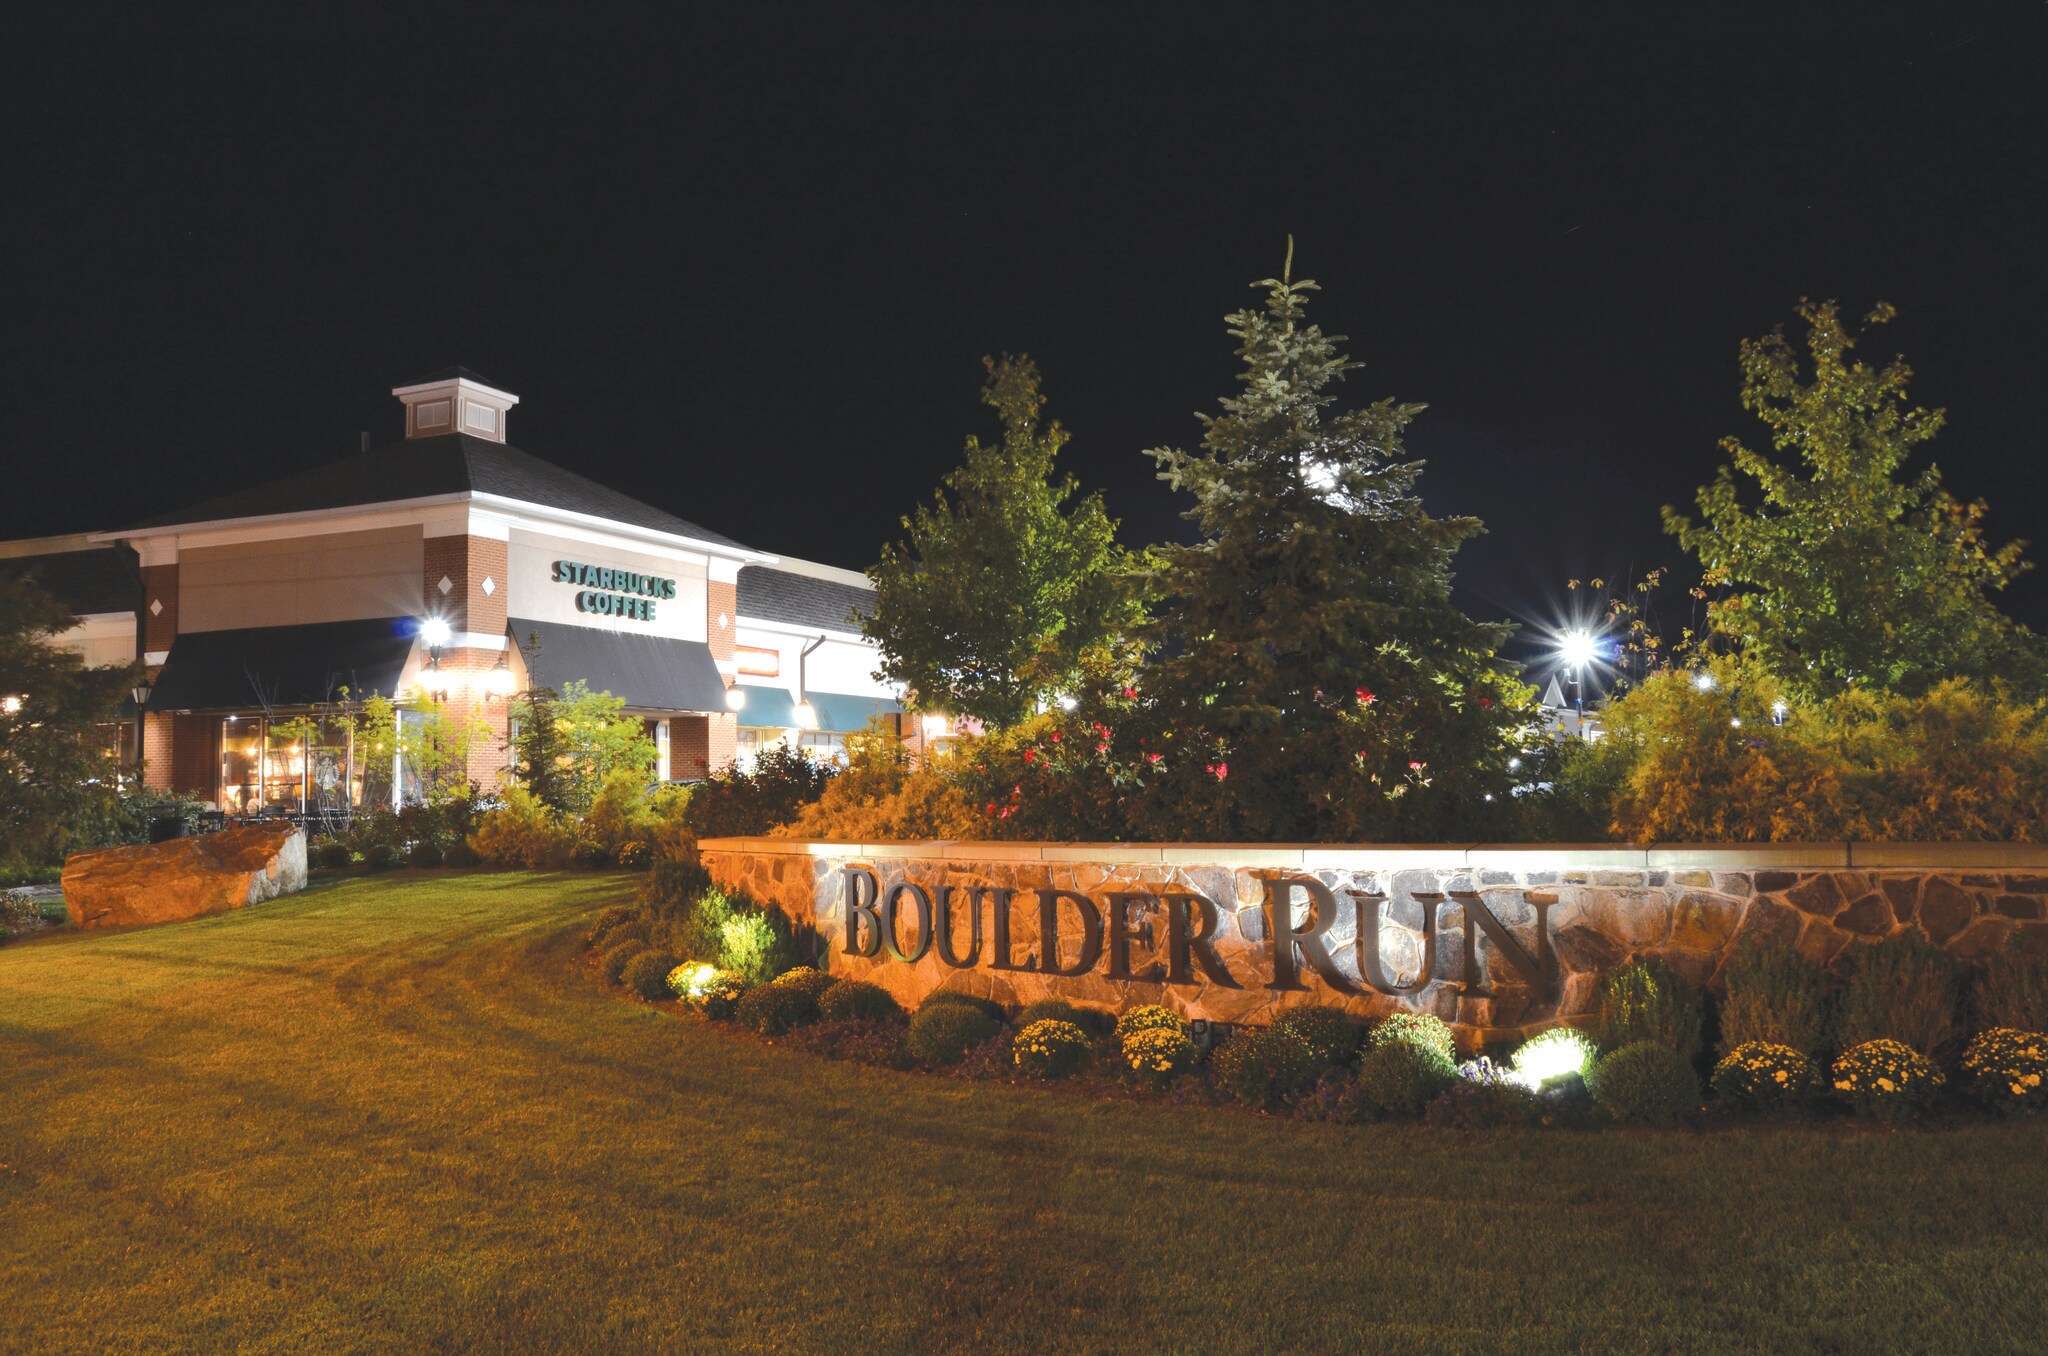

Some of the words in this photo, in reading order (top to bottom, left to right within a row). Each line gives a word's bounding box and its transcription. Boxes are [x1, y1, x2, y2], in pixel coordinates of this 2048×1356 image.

[552, 560, 677, 599] STARBUCKS
[576, 590, 657, 621] COFFEE
[841, 867, 1245, 990] BOULDER
[1254, 869, 1559, 1003] RUN
